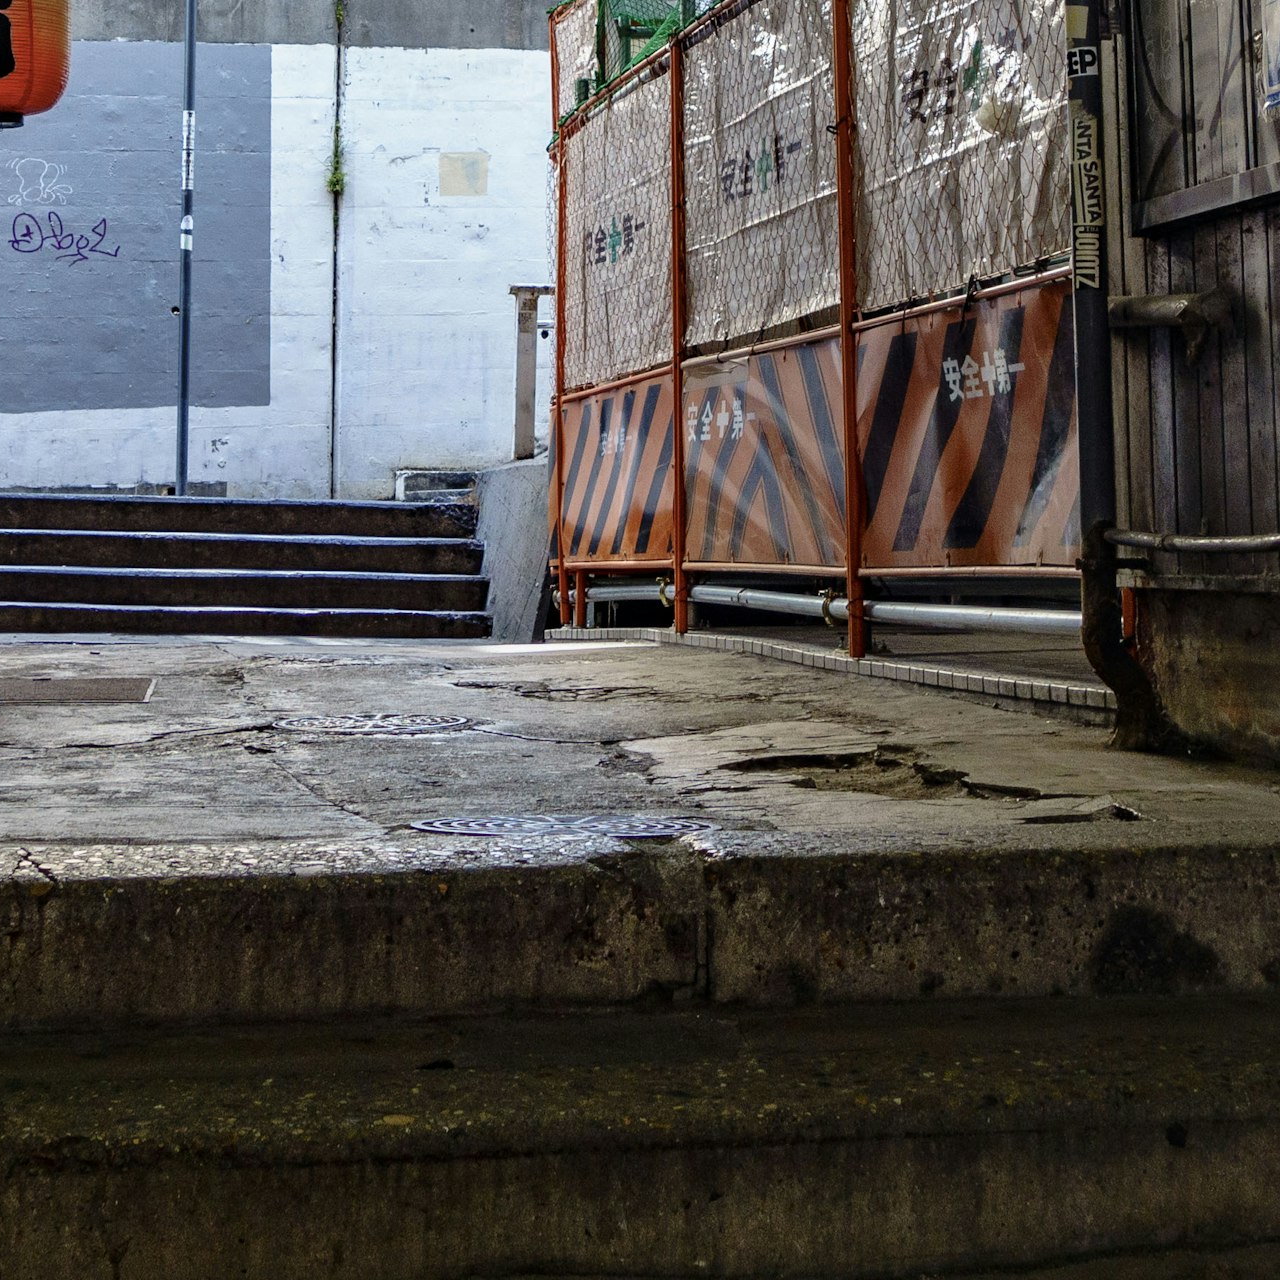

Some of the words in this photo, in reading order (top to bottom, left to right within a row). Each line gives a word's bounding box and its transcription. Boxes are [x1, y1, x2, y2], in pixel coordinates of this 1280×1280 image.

[1076, 120, 1092, 161] NTA
[1082, 160, 1101, 224] SANTA
[687, 396, 757, 442] 安全第一
